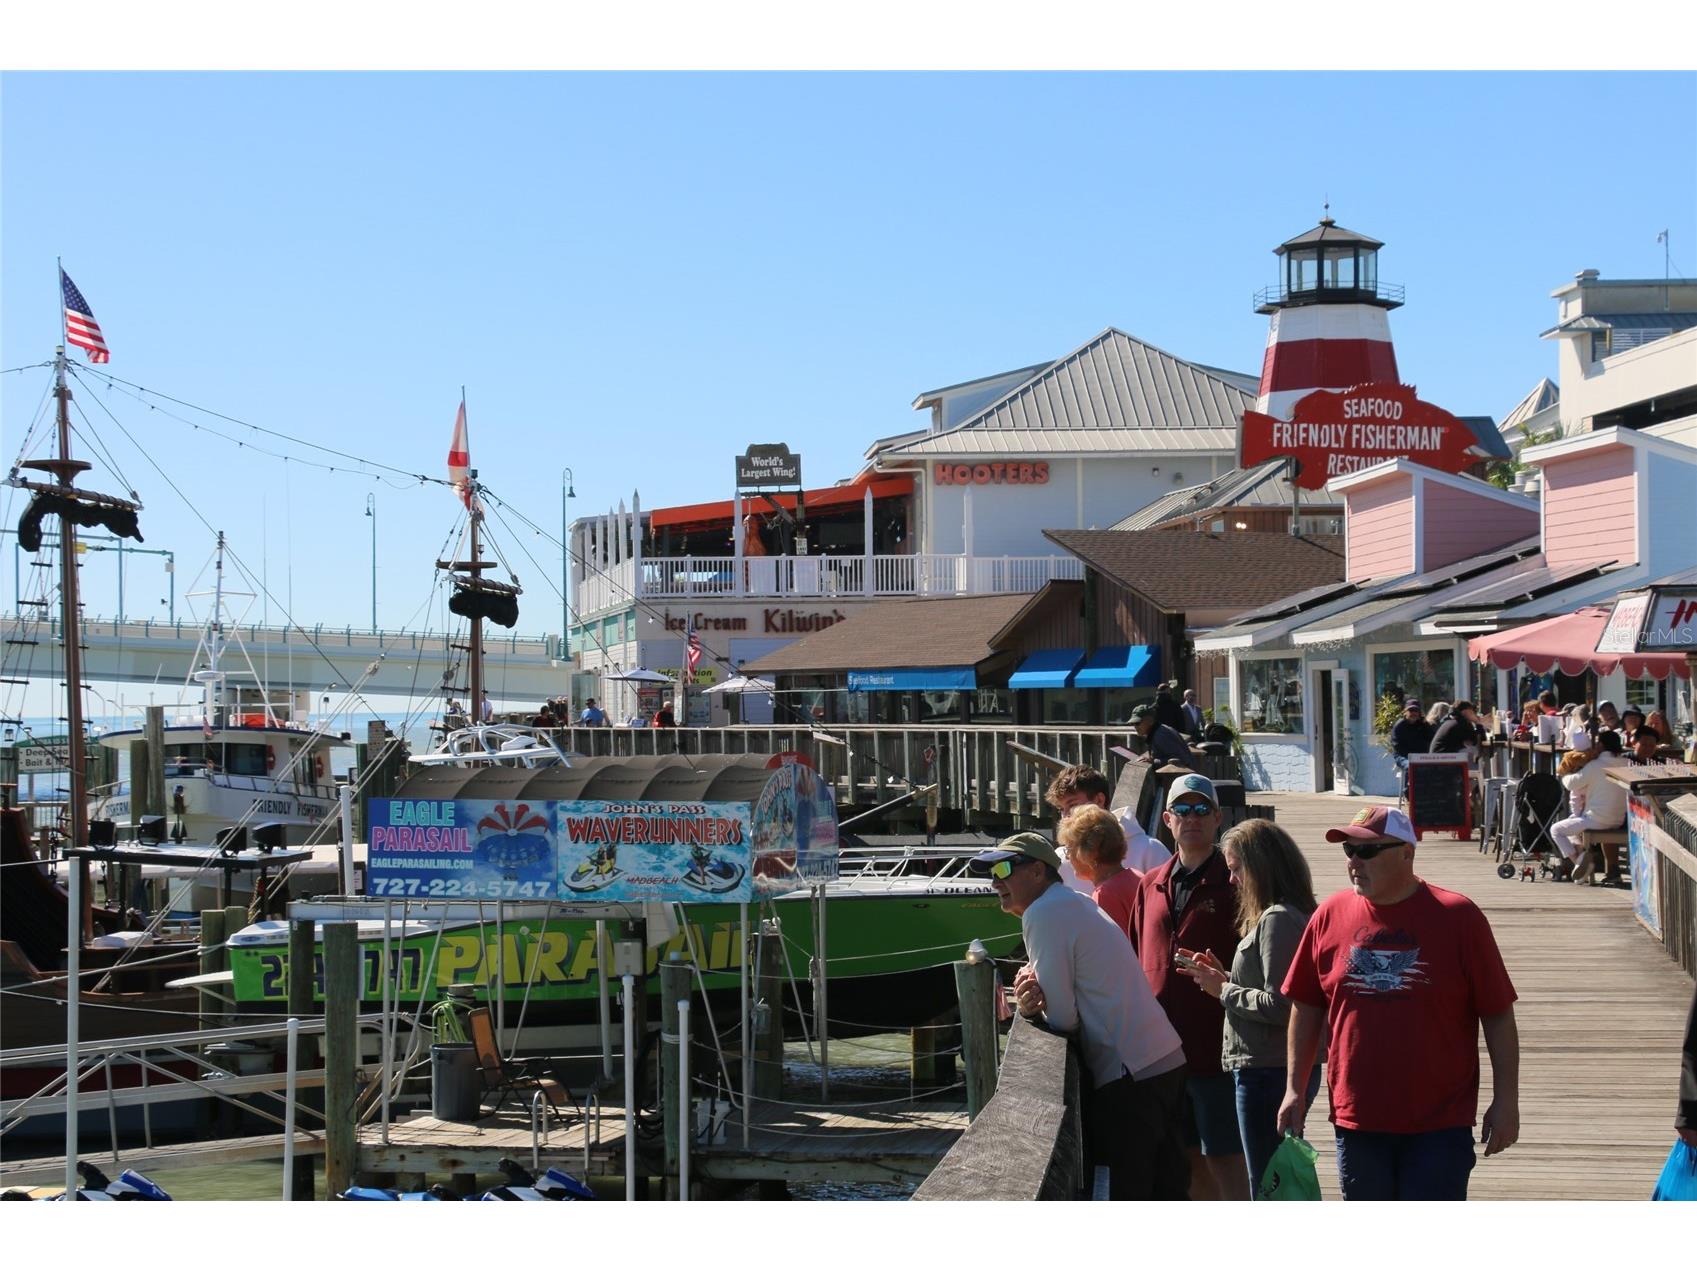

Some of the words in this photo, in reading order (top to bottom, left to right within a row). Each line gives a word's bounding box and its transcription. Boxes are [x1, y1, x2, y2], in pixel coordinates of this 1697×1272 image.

[1343, 398, 1403, 420] SEAFOOD
[1272, 422, 1348, 449] FRIENDLY
[1351, 424, 1442, 451] FISHERMAN
[741, 467, 771, 480] Largest
[772, 465, 796, 479] Wing!
[751, 455, 784, 468] World's
[1327, 453, 1409, 475] RESTAU
[934, 462, 1050, 486] HOOTERS
[664, 609, 687, 632] Ice
[693, 612, 747, 631] Cream
[389, 800, 455, 827] EAGLE
[603, 804, 663, 814] JOHN'S
[668, 804, 706, 815] PASS
[371, 826, 473, 853] PARASAIL
[566, 816, 745, 846] WAVERUNNERS
[371, 858, 474, 870] EAGLEPARASAILING.COM
[372, 877, 551, 898] 727-224-5747
[436, 921, 752, 989] PARAAI
